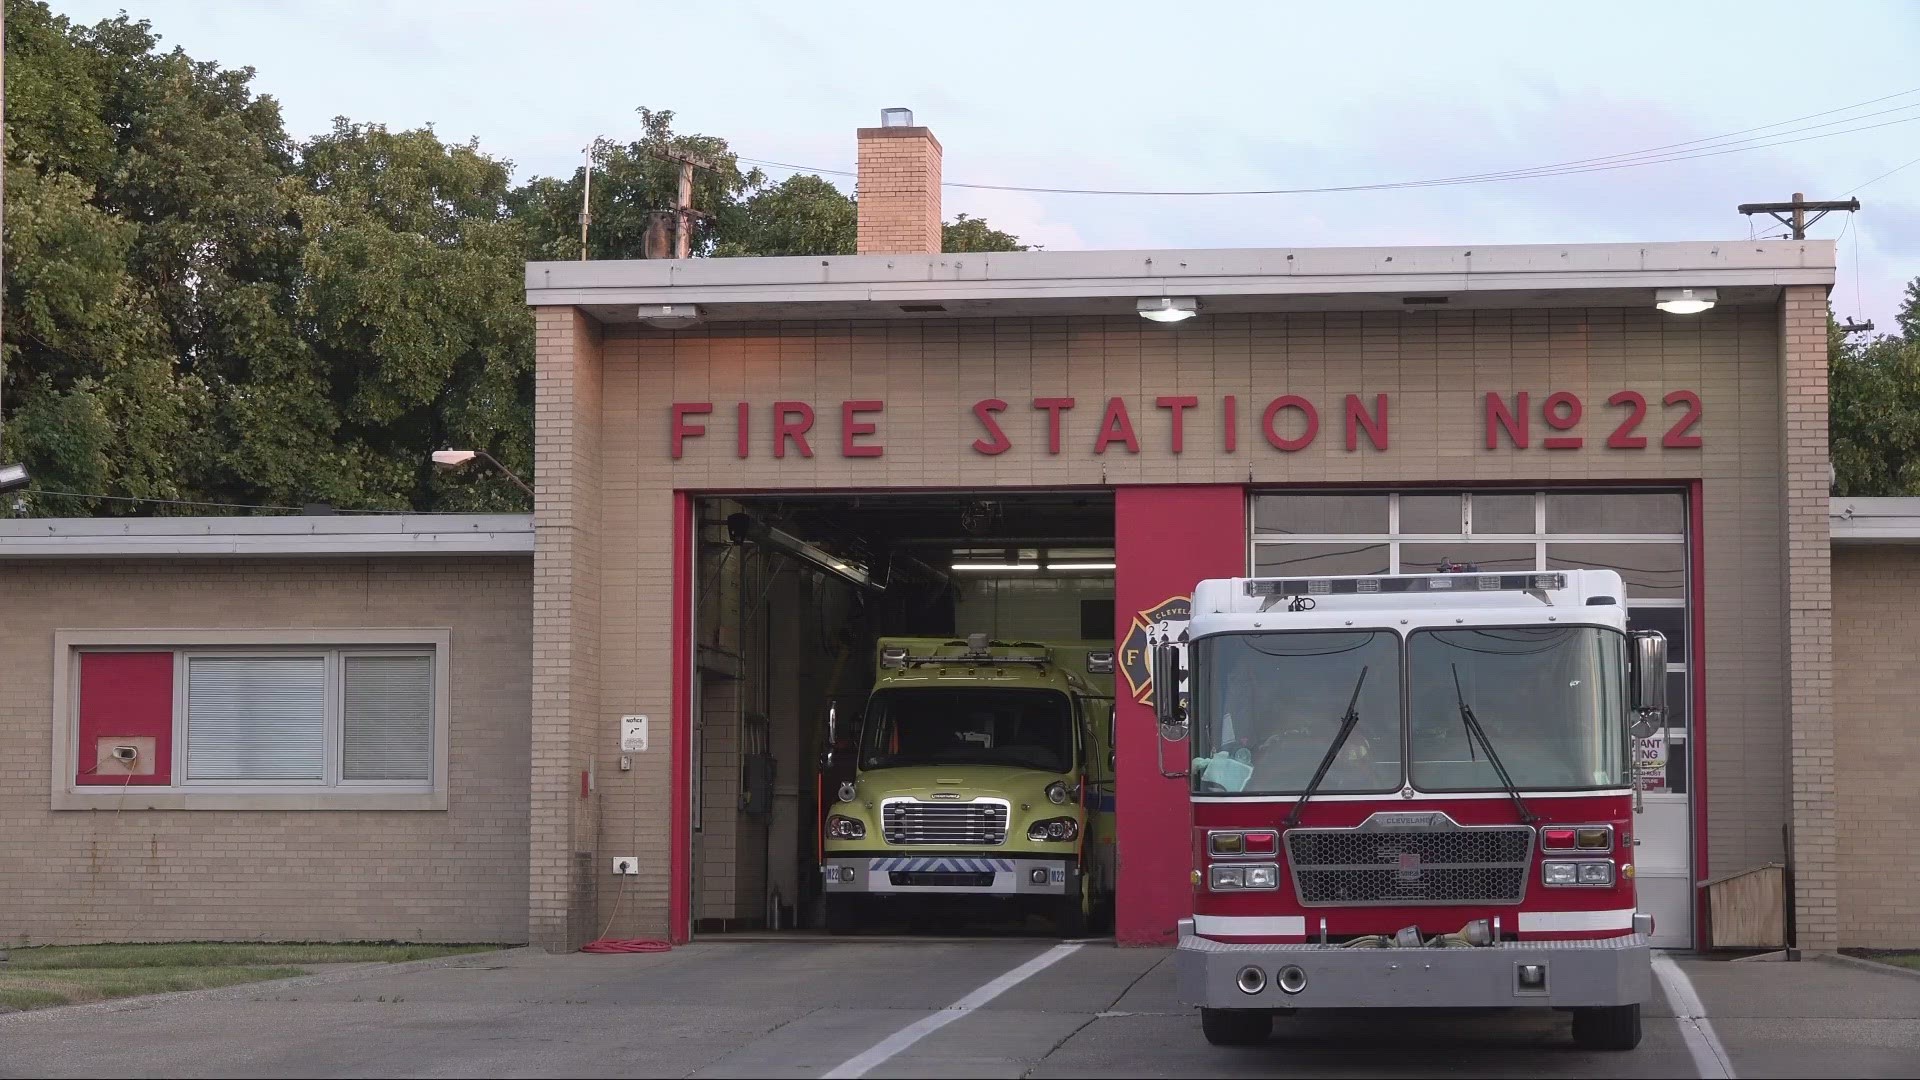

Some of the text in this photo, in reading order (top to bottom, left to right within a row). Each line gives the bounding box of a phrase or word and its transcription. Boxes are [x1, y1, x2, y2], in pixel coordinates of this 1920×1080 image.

[674, 402, 882, 456] FIRE
[976, 395, 1388, 452] STATION
[1149, 625, 1155, 636] 2
[1162, 621, 1169, 631] 2
[1127, 649, 1139, 665] F
[1051, 870, 1065, 882] M22
